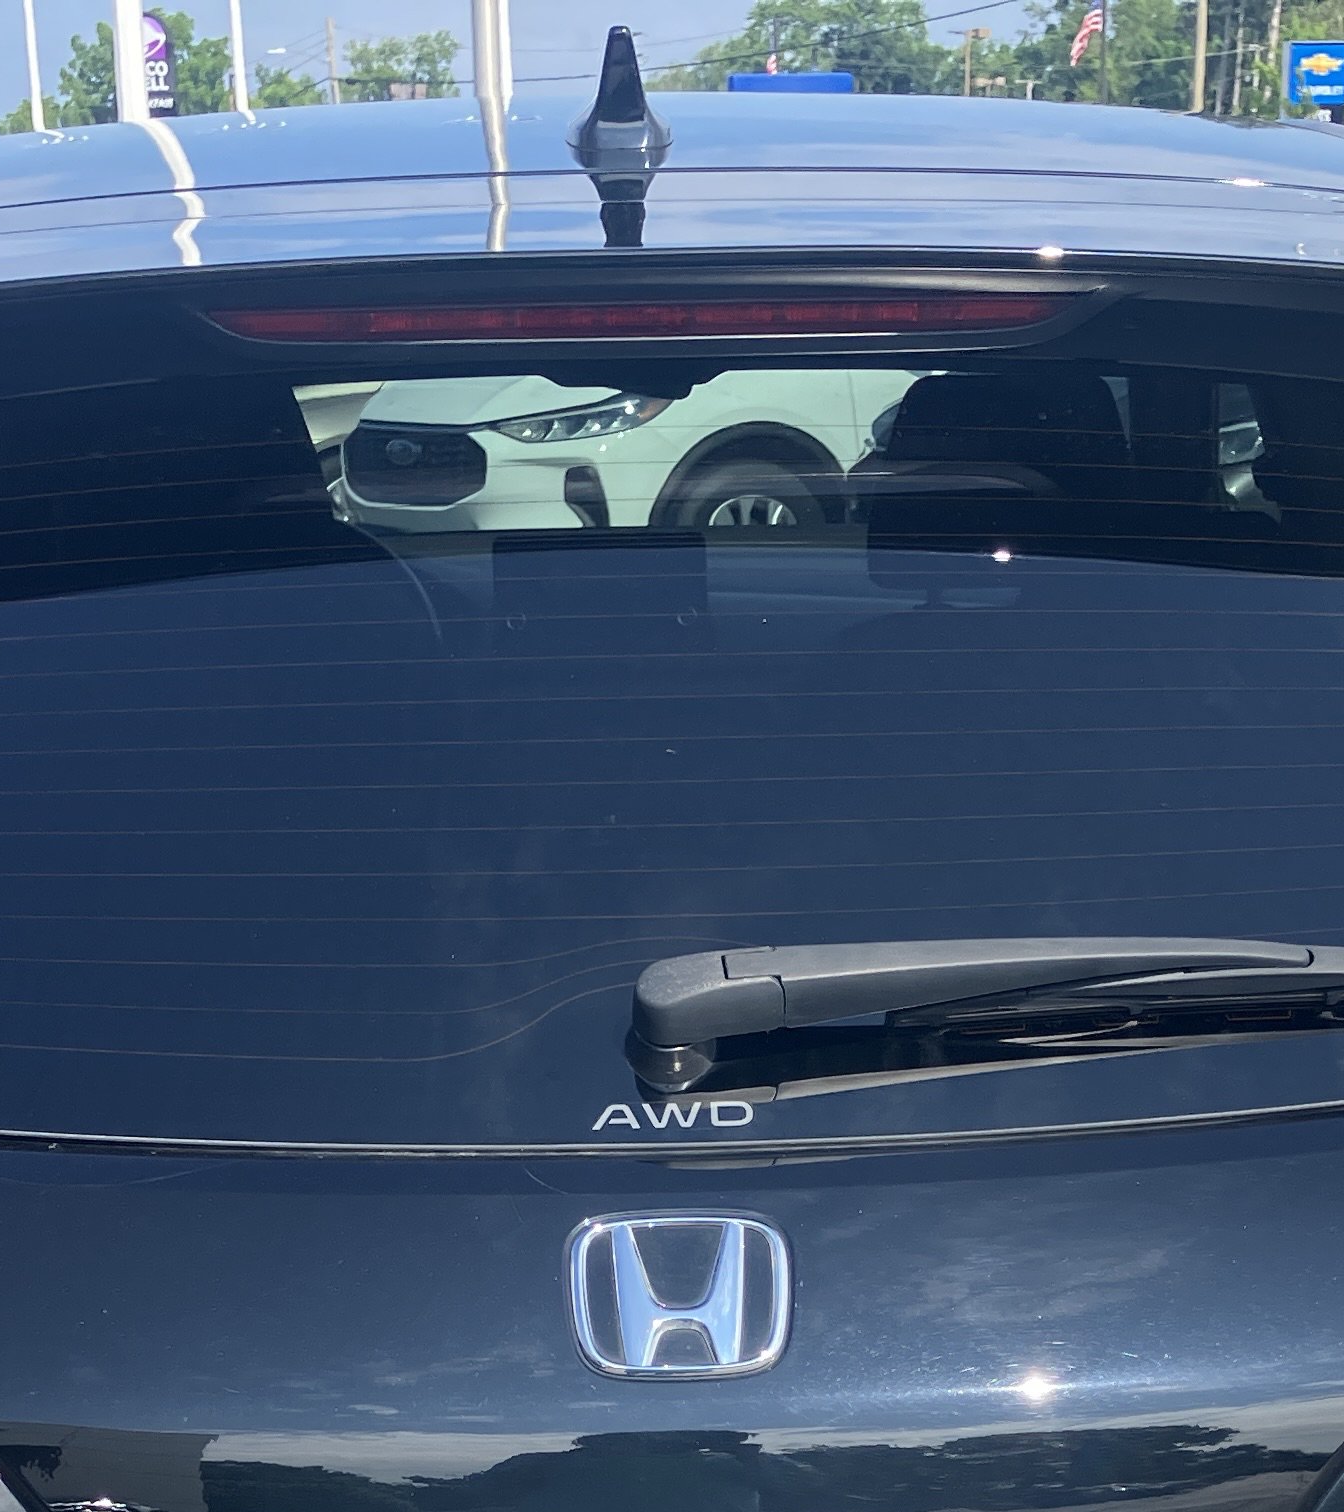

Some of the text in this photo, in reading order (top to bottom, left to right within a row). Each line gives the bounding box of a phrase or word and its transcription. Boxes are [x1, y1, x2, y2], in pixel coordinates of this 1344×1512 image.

[145, 61, 168, 77] CO
[146, 76, 170, 91] ELL
[592, 1101, 755, 1131] AWD
